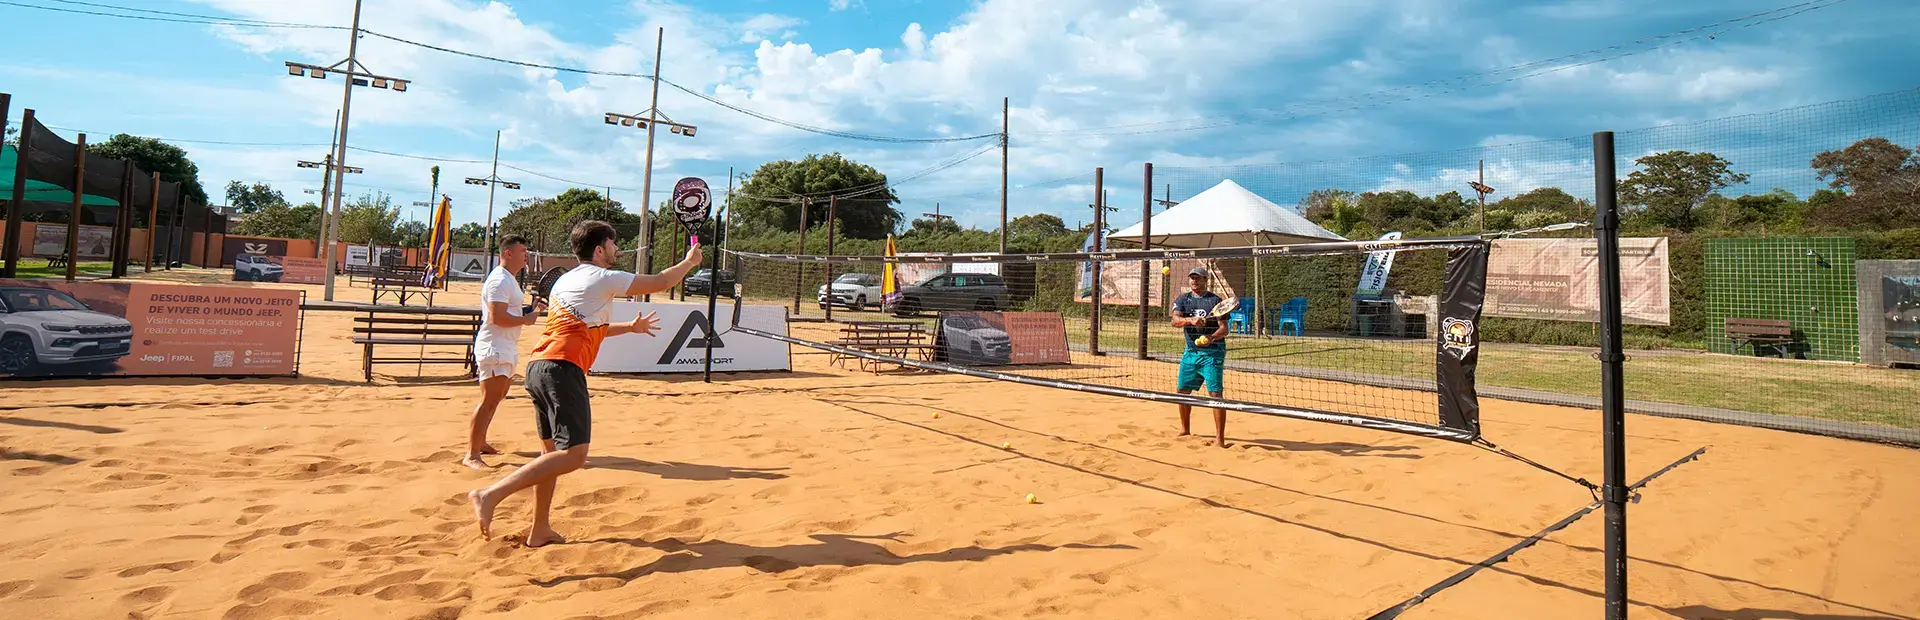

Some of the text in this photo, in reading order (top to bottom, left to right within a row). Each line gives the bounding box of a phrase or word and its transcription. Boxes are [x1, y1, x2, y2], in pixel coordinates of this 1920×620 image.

[1486, 279, 1568, 288] ESIDENCIAL NEVADA
[151, 294, 293, 306] DESCUBRA UM NOVO JEITO
[148, 305, 282, 317] DE VIVER O MUNDO JEEP.
[146, 316, 173, 325] Visite
[207, 317, 275, 327] concessionária
[144, 327, 178, 335] realize
[199, 327, 217, 335] test
[219, 328, 243, 336] drive
[1445, 333, 1469, 343] CITI
[139, 354, 165, 363] Jeep
[699, 357, 734, 365] SORT
